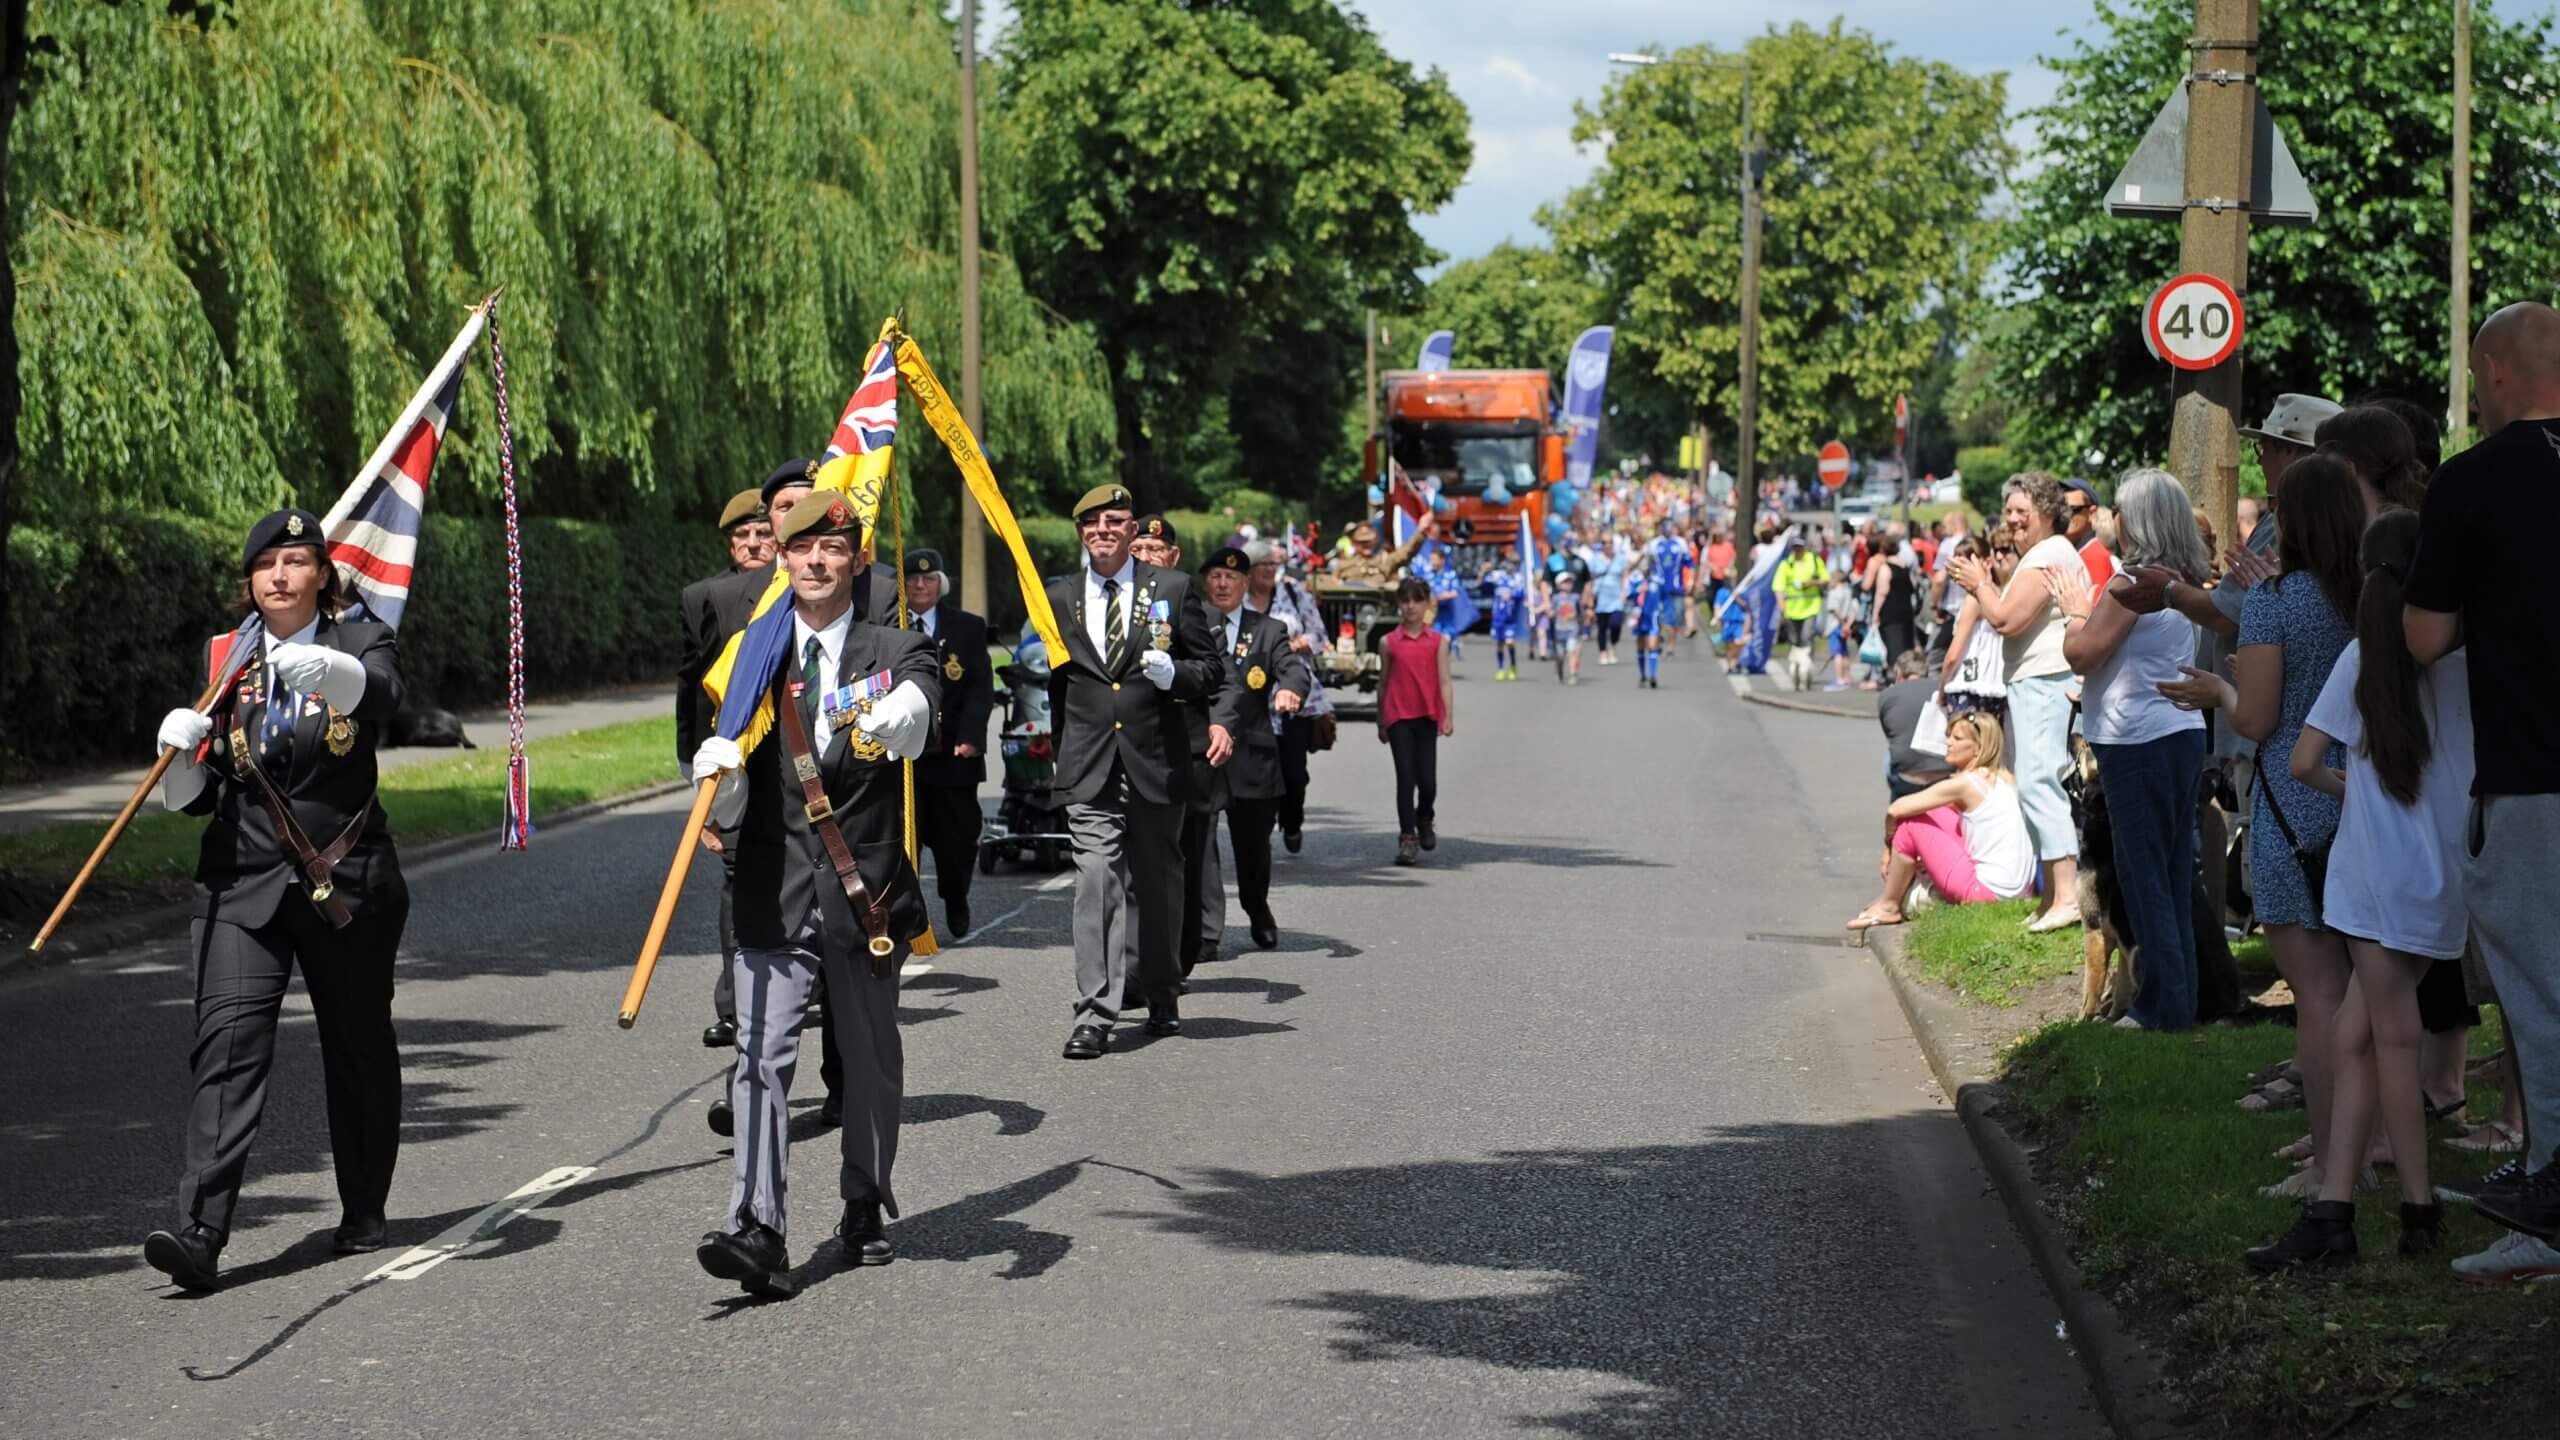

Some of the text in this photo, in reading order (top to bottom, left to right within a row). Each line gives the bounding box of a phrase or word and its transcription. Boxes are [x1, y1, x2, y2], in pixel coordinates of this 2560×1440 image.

[2163, 302, 2229, 339] 40
[911, 374, 941, 410] 1921
[945, 421, 974, 461] 1996
